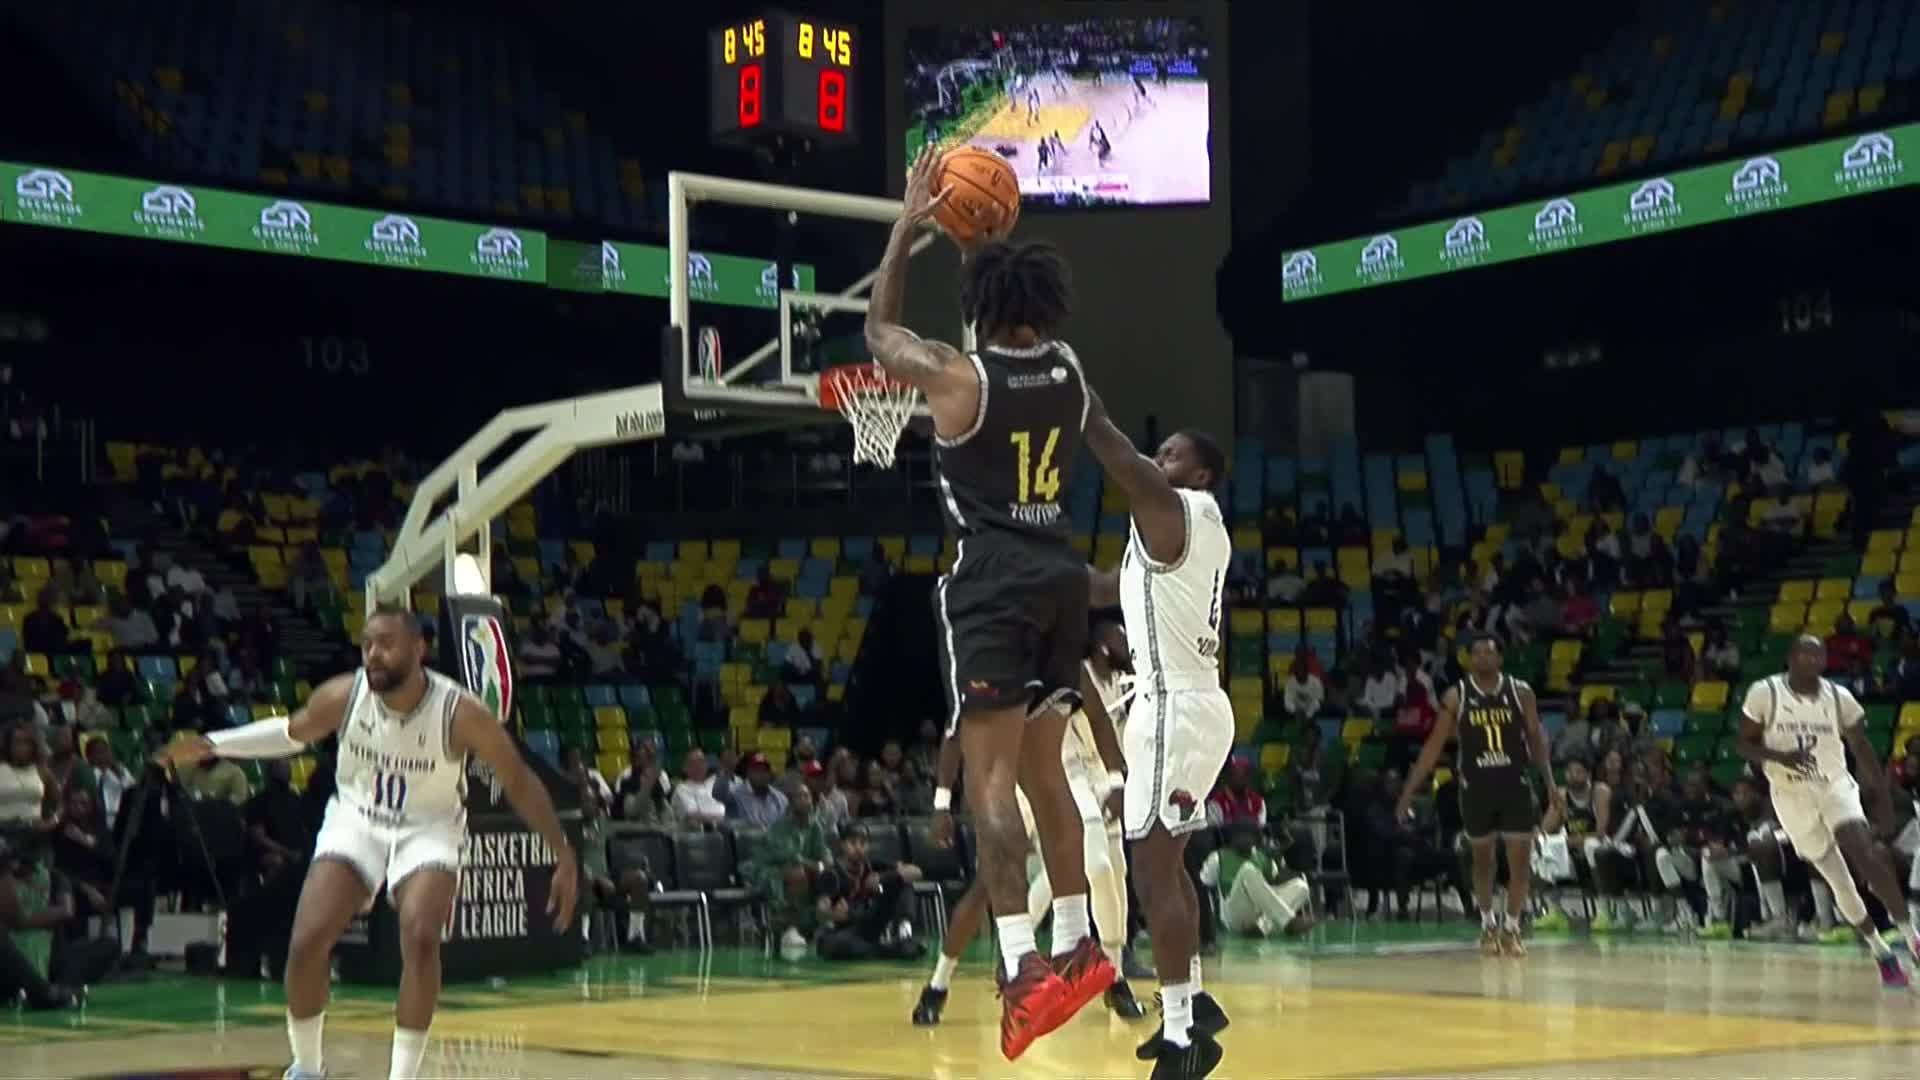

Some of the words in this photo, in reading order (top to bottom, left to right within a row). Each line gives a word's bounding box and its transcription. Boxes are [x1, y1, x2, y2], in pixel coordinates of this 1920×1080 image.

[725, 28, 736, 64] 8
[743, 20, 764, 57] 45
[799, 23, 814, 58] 8
[823, 28, 851, 66] 45
[739, 64, 762, 128] 8
[819, 70, 847, 133] 8
[299, 336, 369, 375] 103
[1010, 426, 1060, 503] 14
[1485, 725, 1502, 753] 11
[375, 770, 406, 809] 10
[462, 868, 526, 903] AFRICA
[461, 902, 528, 938] LEAGUE
